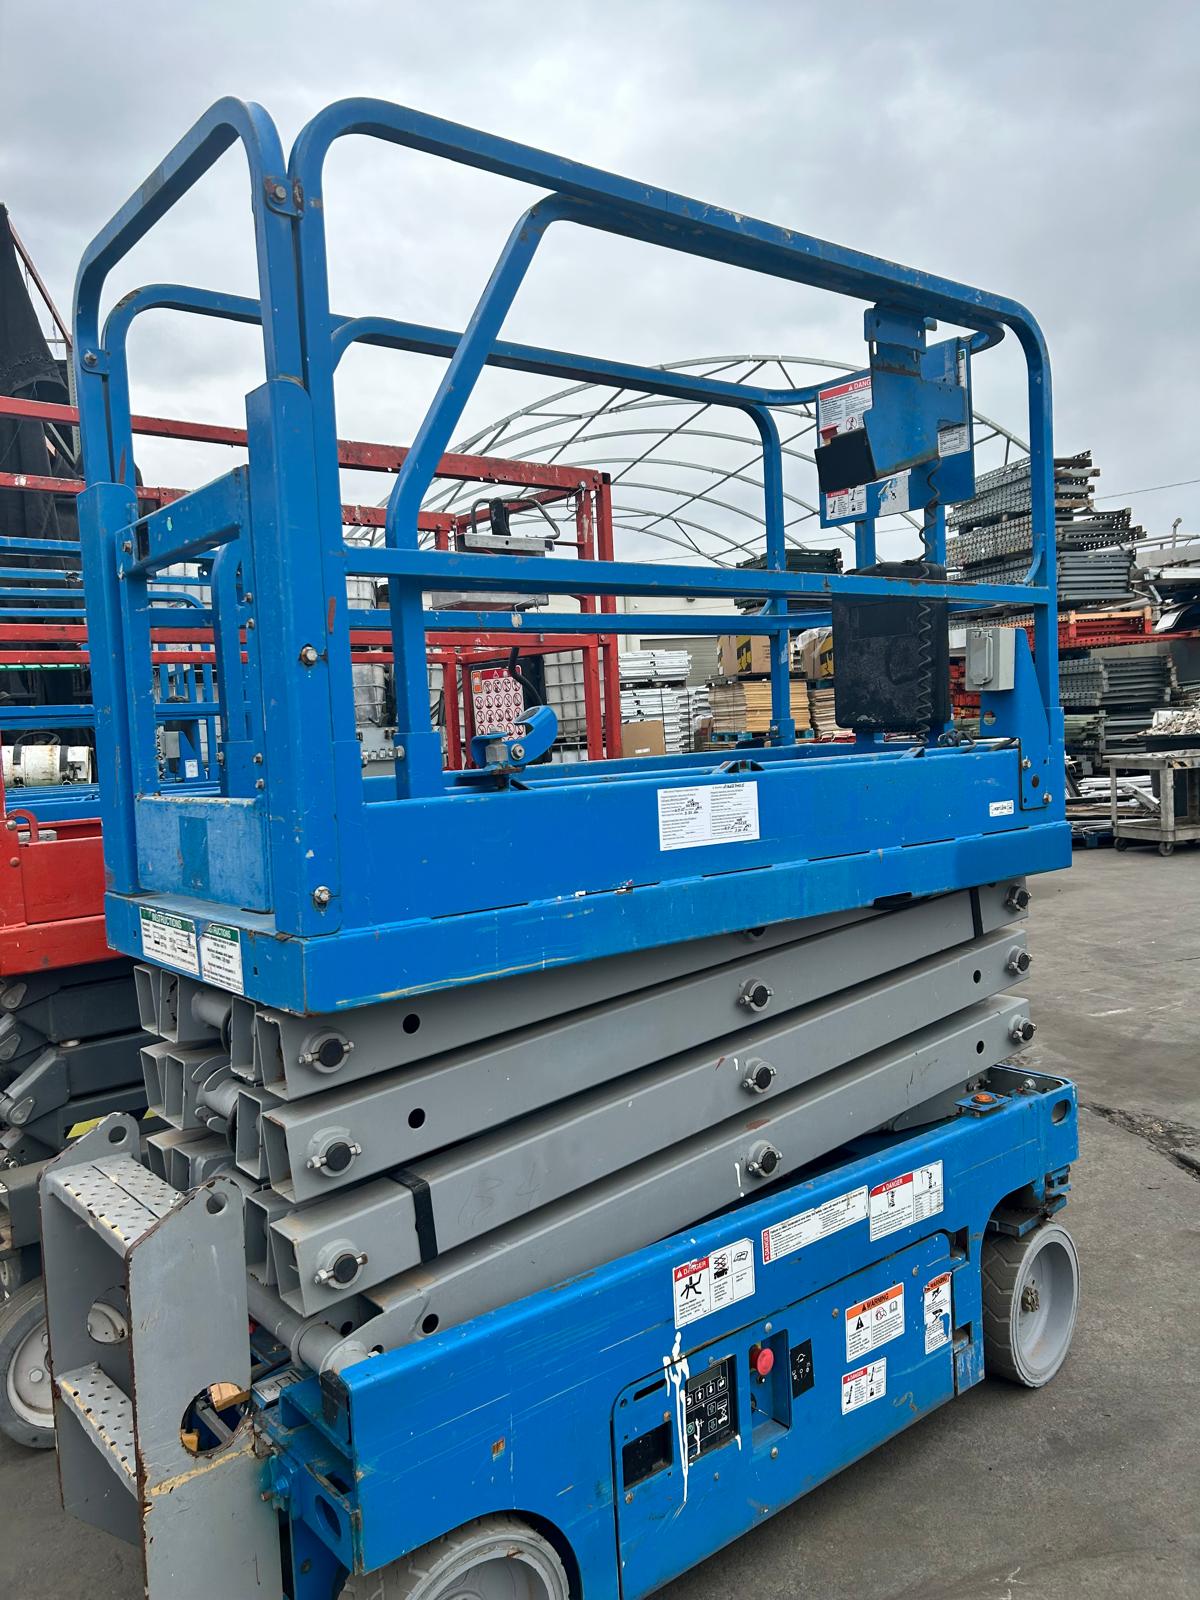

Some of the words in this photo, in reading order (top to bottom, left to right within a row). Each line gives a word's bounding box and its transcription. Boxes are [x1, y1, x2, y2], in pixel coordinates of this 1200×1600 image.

[853, 379, 871, 390] DANG
[886, 1178, 903, 1190] DANGER
[866, 1293, 889, 1309] WARNING
